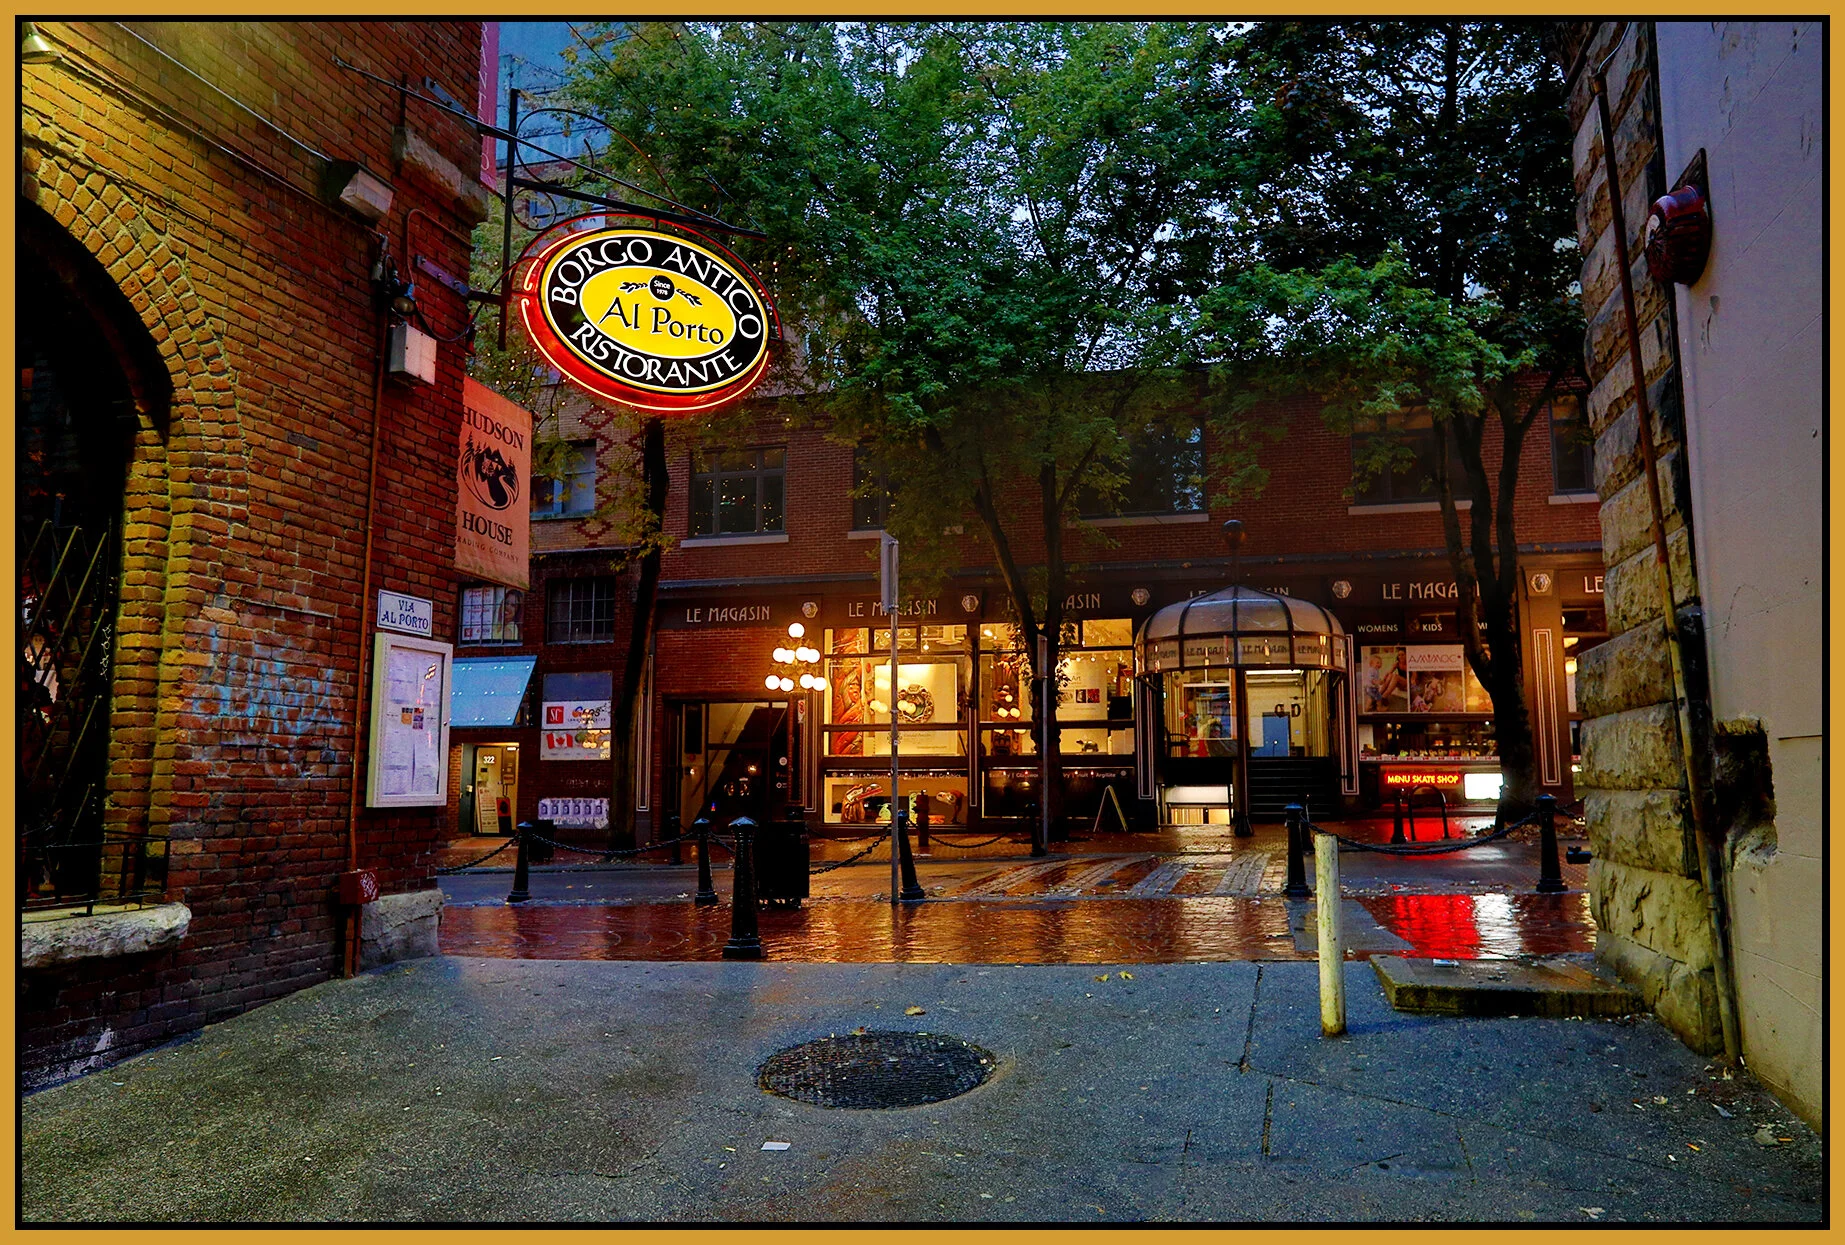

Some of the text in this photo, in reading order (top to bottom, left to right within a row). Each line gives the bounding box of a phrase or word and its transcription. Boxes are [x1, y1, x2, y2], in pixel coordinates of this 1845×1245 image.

[551, 239, 762, 339] BORGO ANTICO
[653, 280, 671, 289] Since
[597, 296, 725, 345] Al Porto
[570, 322, 743, 387] RISTORANTE
[462, 404, 523, 451] HUDSON
[462, 510, 512, 546] HOUSE
[457, 535, 485, 551] RADING
[1382, 581, 1480, 600] LE MAGA
[1584, 576, 1604, 593] LE
[398, 599, 415, 613] VIA
[686, 605, 771, 623] LE MAGASIN
[848, 602, 865, 617] LE
[381, 610, 429, 630] AL PORTO
[1357, 624, 1399, 633] WOMENS
[1422, 623, 1443, 632] KIDS
[483, 755, 496, 764] 322
[1387, 775, 1459, 784] MENU SKATE SHOP
